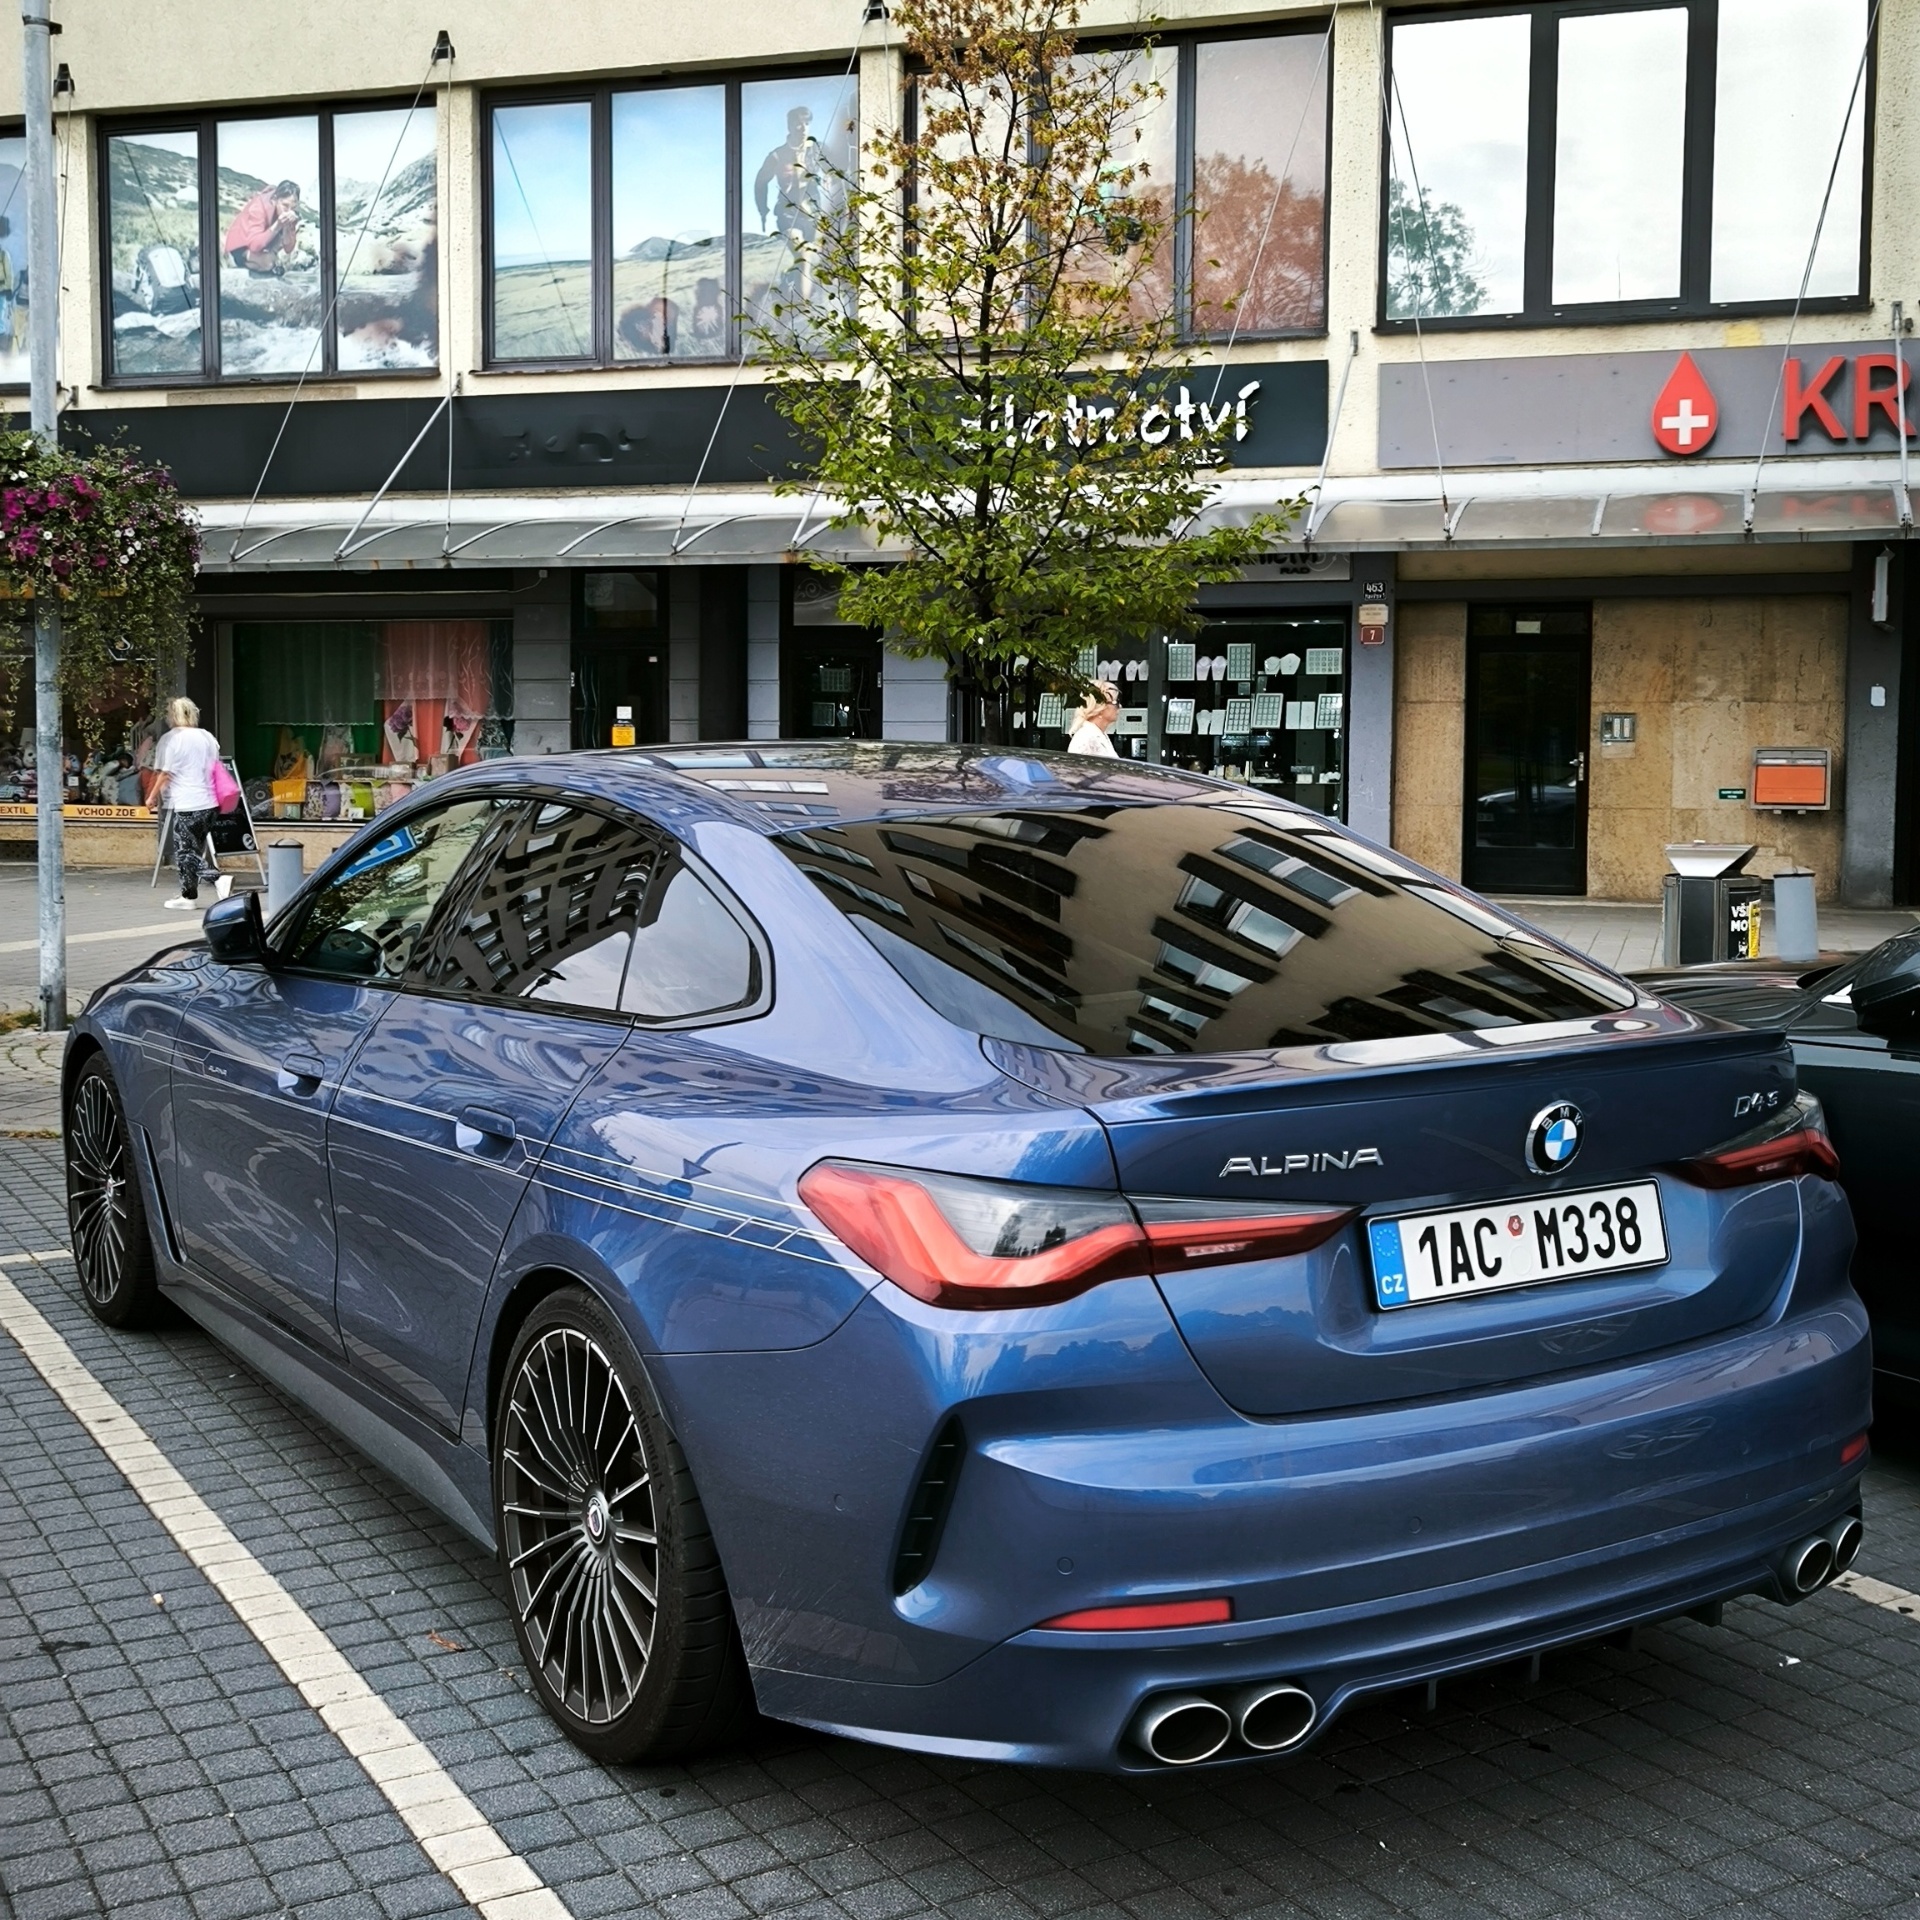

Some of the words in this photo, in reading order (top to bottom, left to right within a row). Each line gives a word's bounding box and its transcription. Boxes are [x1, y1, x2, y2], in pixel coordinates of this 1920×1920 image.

[1370, 629, 1376, 641] 7
[77, 807, 113, 817] VCHOD
[116, 808, 136, 817] ZDE
[1219, 1147, 1384, 1178] ALPINA
[1418, 1217, 1503, 1288] 1AC
[1533, 1196, 1643, 1270] M338
[1381, 1273, 1405, 1295] CZ
[629, 1384, 663, 1479] Continental
